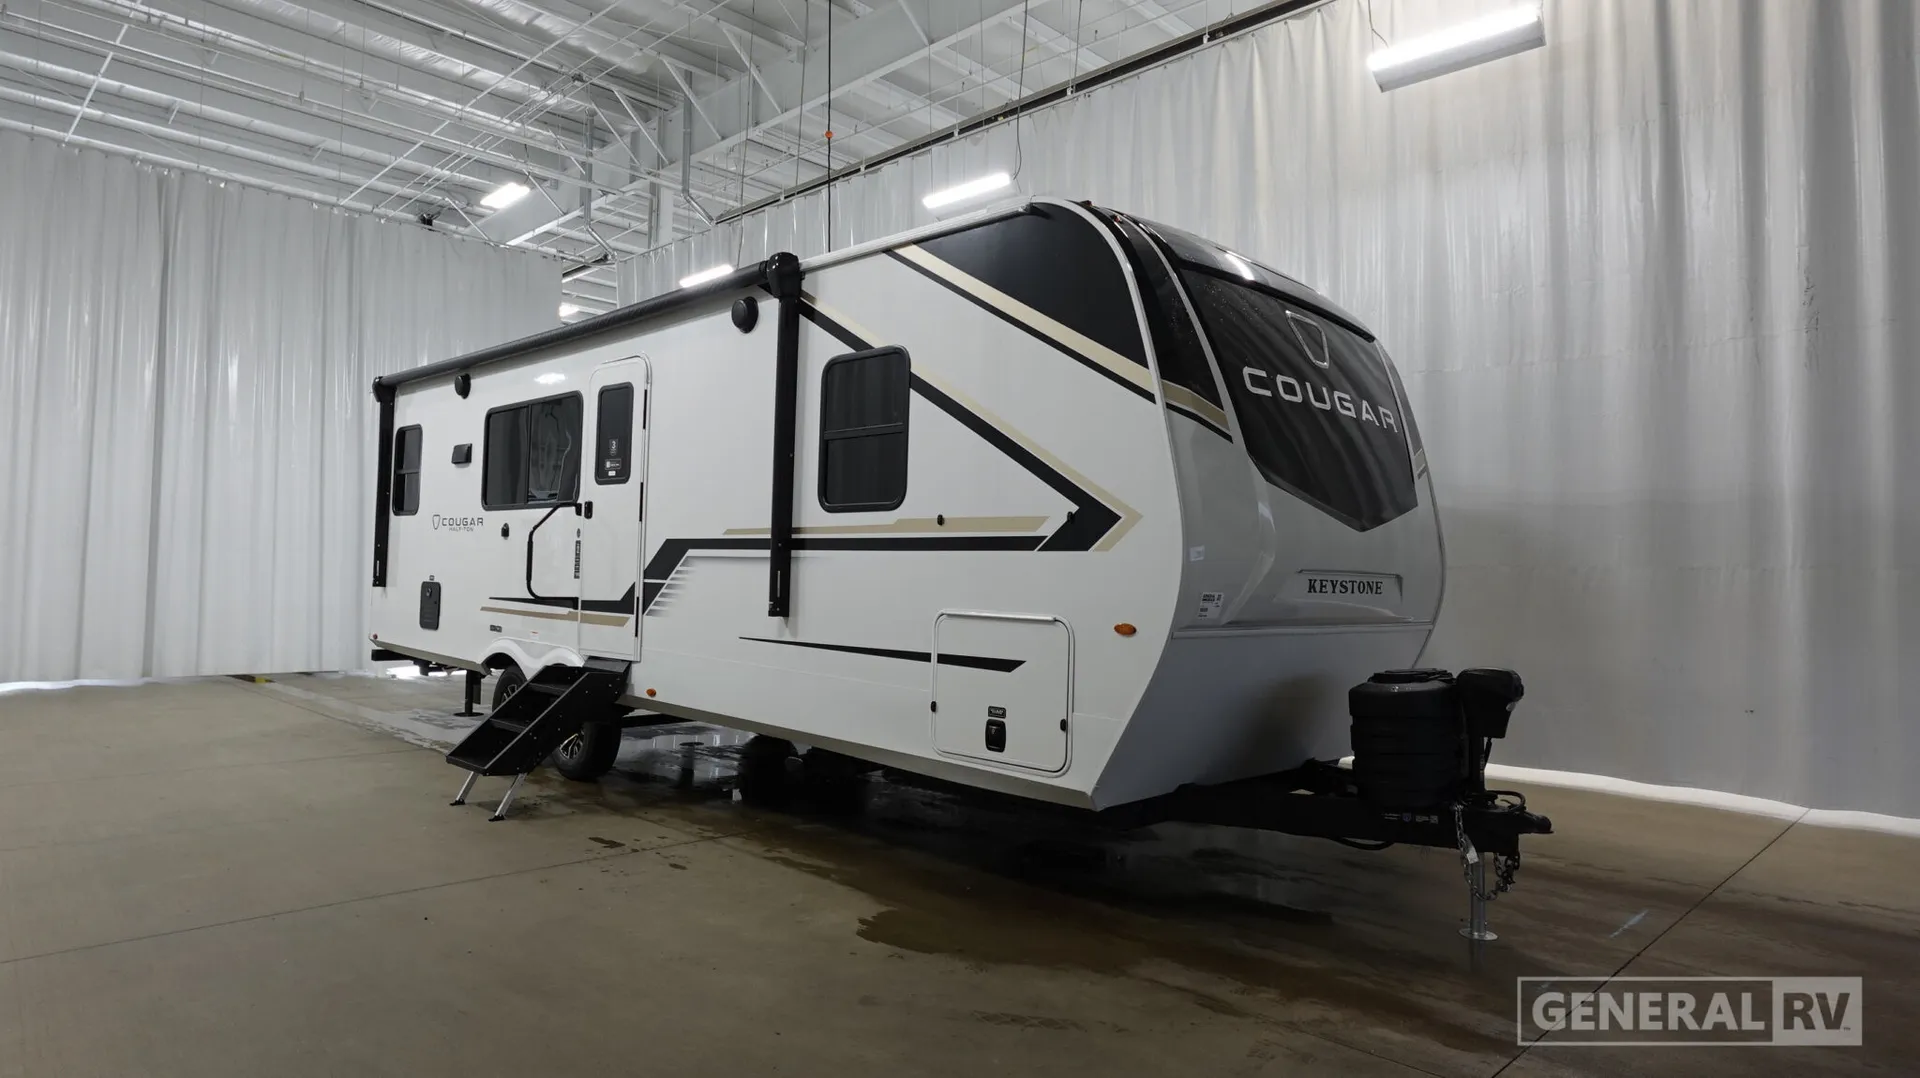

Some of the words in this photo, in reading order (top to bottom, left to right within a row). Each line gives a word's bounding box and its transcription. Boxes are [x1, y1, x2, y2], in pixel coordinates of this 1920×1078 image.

[1242, 366, 1398, 433] COUGAR
[441, 517, 484, 527] COUGAR
[1307, 578, 1383, 595] KEYSTONE
